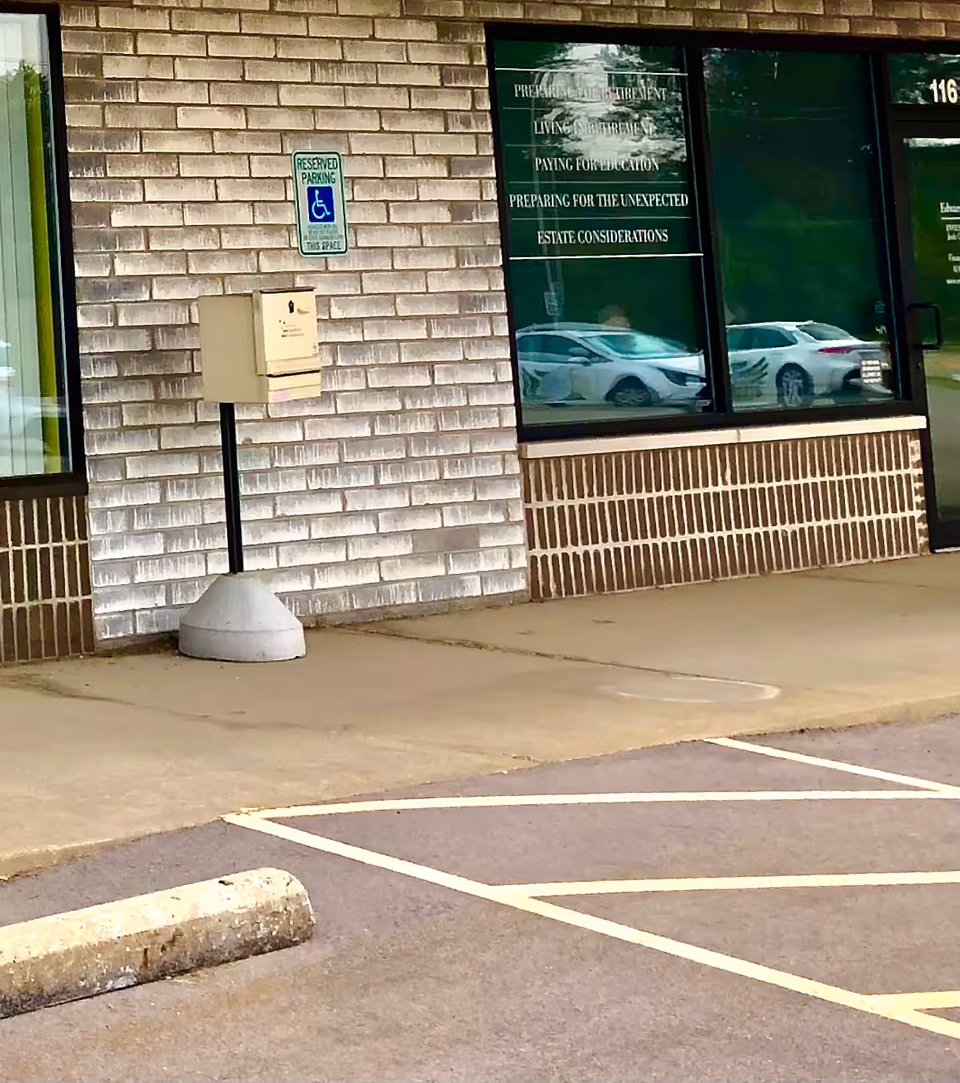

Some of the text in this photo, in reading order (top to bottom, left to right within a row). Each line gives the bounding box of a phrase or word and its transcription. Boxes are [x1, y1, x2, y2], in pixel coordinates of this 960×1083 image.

[928, 78, 958, 104] 116
[533, 120, 571, 135] LIVING
[297, 157, 338, 171] RESERVED
[535, 157, 660, 172] PAYING FOR EDUCATION
[302, 172, 336, 185] PARKING
[509, 193, 689, 208] PREPARING FOR THE UNEXPECTED
[537, 228, 669, 245] ESTATE CONSIDERATIONS
